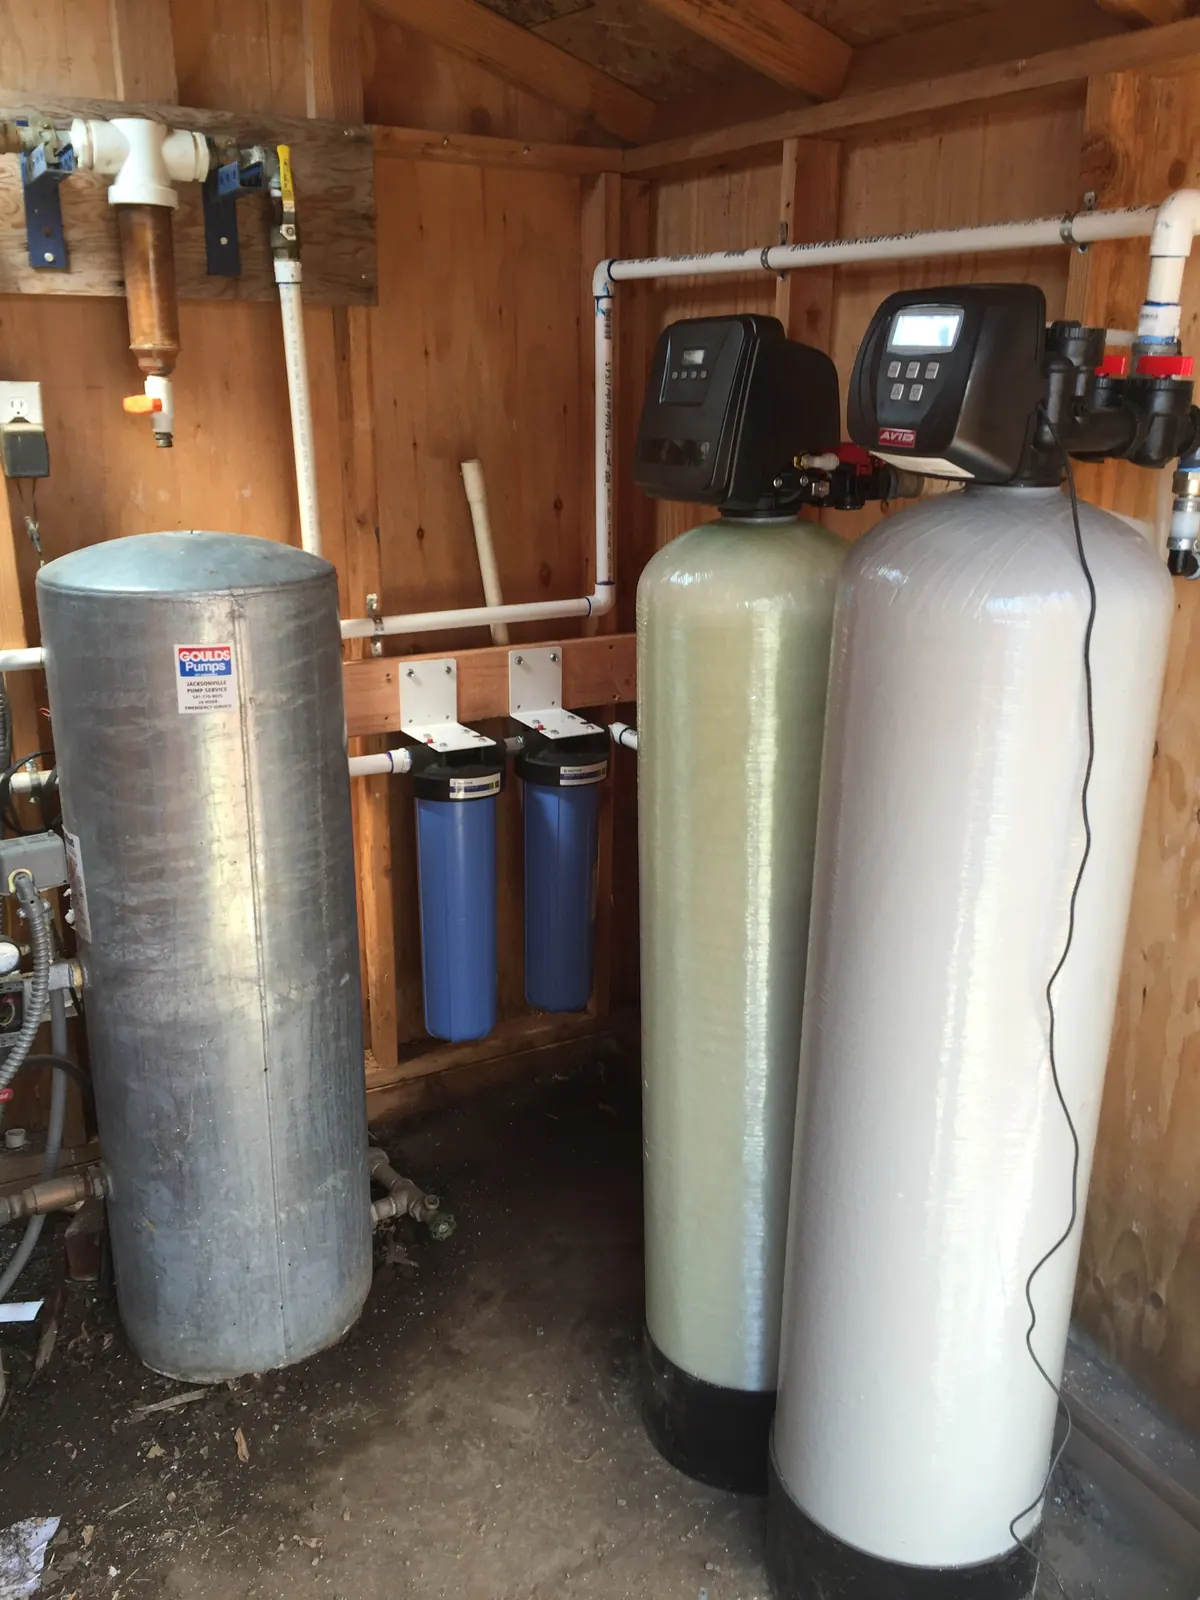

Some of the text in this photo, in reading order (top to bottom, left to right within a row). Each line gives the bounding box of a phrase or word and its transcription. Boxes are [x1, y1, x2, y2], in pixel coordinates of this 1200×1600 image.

[880, 430, 914, 442] AVID
[180, 650, 230, 662] GOULDS
[185, 661, 226, 673] Pumps
